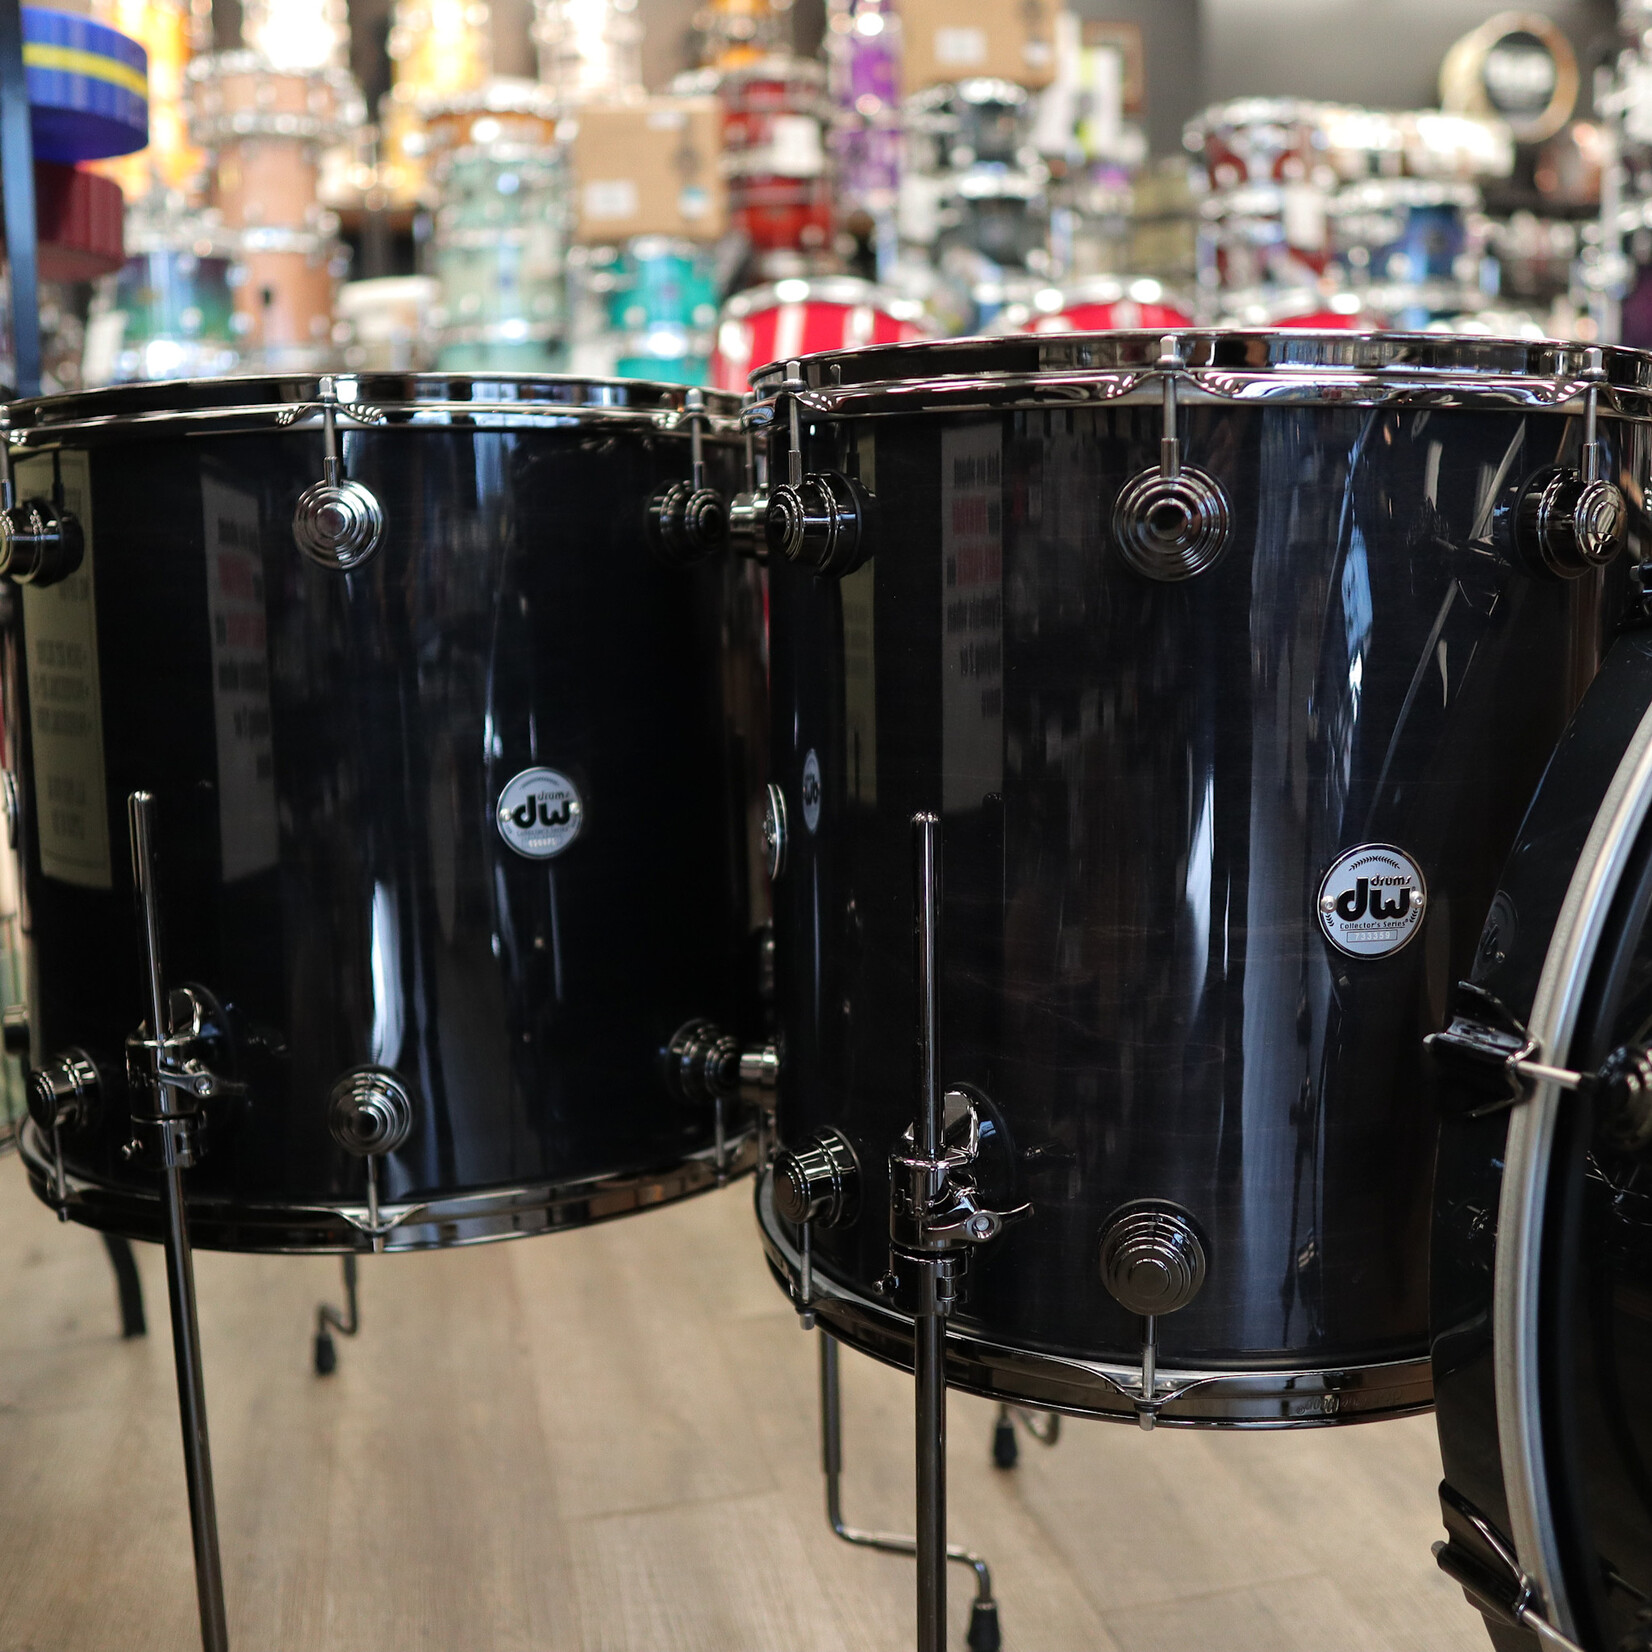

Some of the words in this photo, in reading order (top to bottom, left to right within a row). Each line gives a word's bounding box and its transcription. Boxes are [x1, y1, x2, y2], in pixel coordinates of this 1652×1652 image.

[512, 794, 570, 828] dw
[1370, 873, 1412, 887] drums
[1336, 876, 1411, 922] dw
[1339, 921, 1381, 930] Collector's
